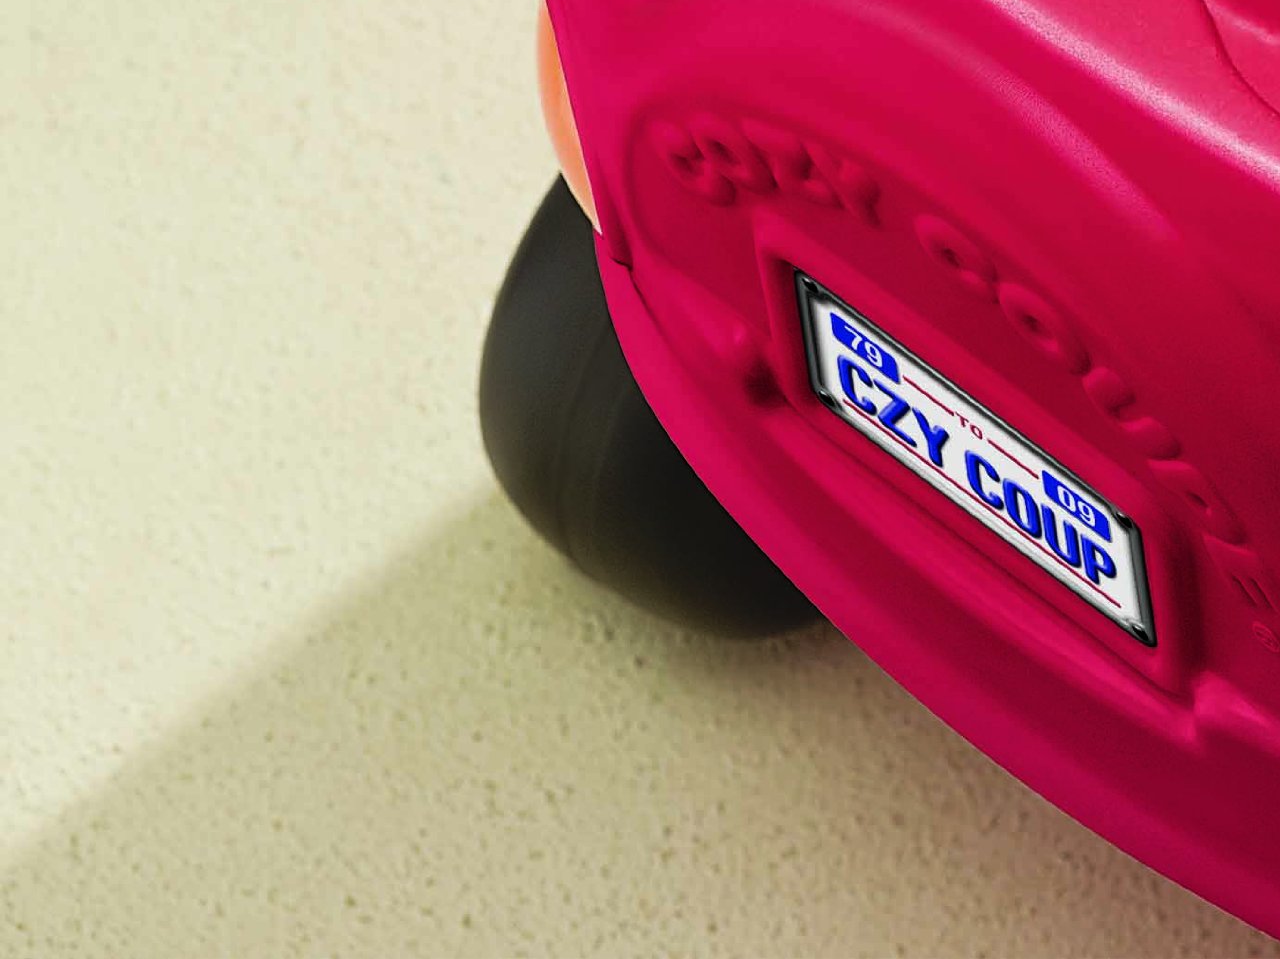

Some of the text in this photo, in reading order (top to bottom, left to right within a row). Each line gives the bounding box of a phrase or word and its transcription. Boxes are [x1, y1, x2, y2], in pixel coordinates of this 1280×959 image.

[844, 324, 883, 368] 79
[954, 411, 984, 440] TO
[837, 353, 1118, 585] CZY COUP
[1055, 483, 1096, 525] 09
